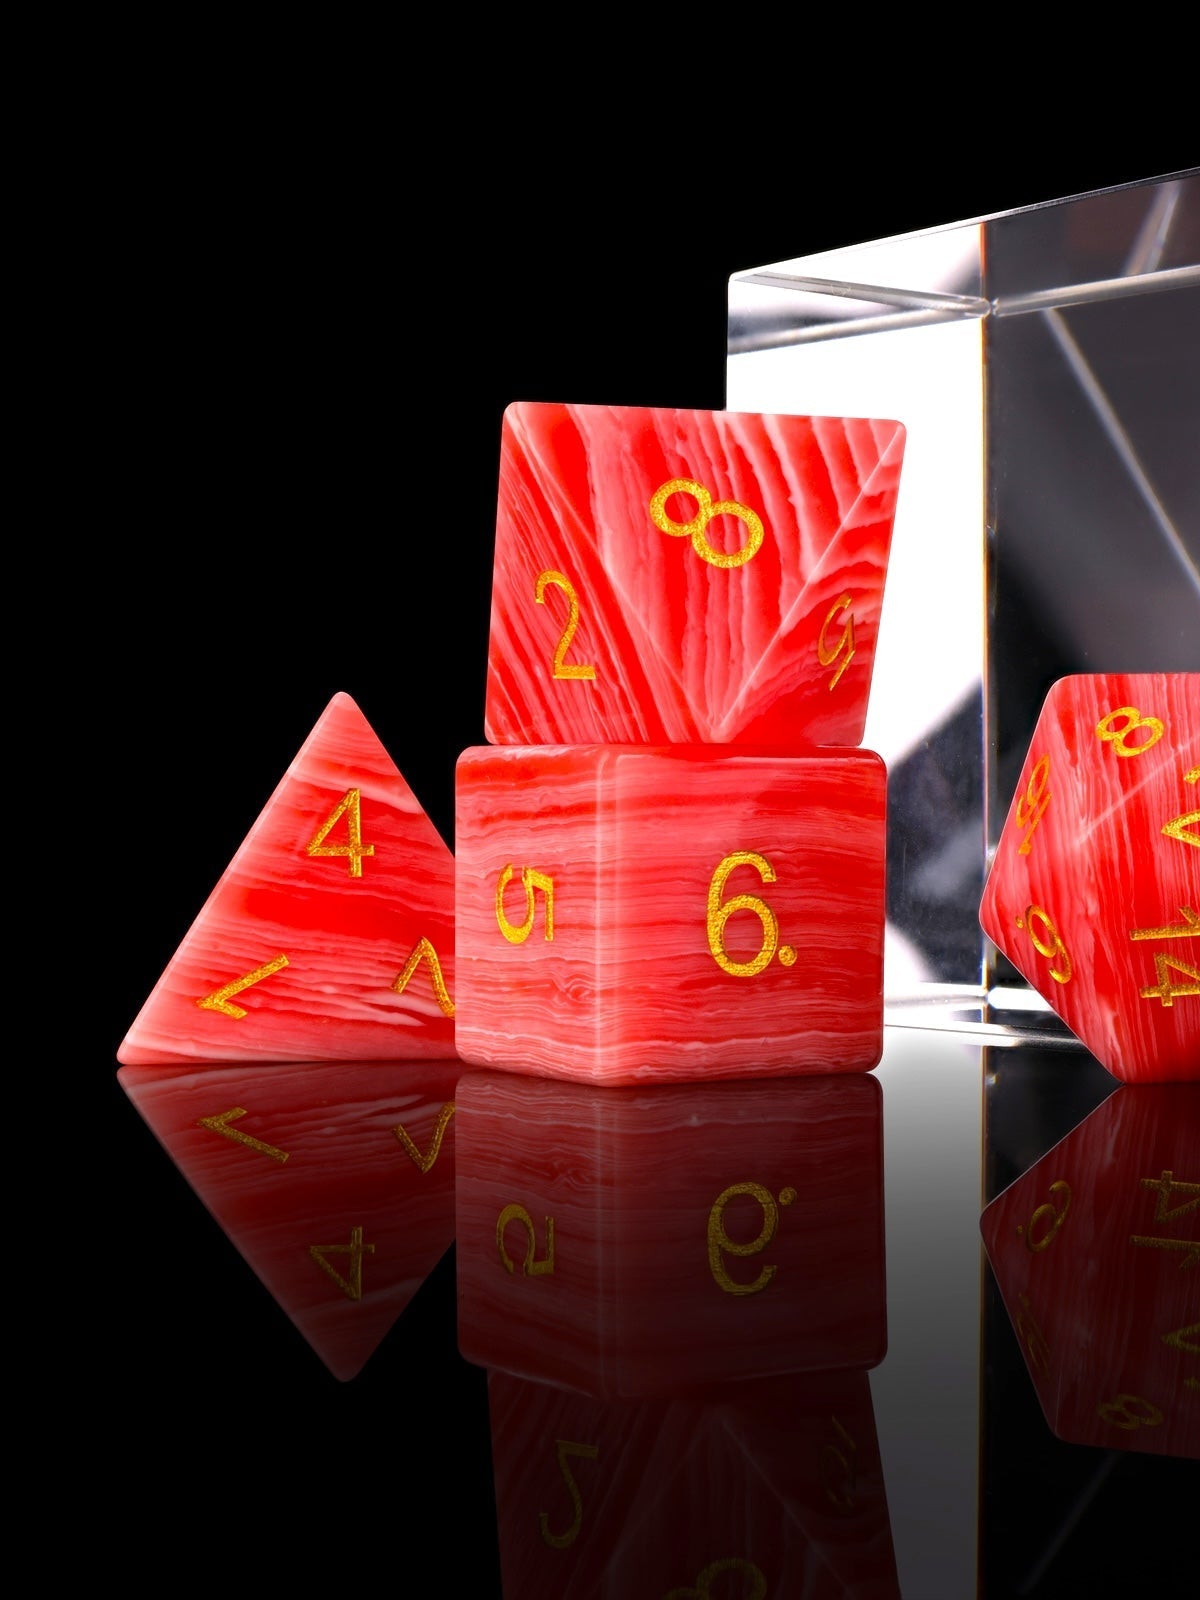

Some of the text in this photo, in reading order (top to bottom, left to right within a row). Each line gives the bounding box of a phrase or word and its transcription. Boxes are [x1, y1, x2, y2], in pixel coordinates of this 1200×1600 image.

[650, 478, 764, 568] 8
[535, 569, 596, 680] 2
[1095, 707, 1165, 757] 8
[308, 788, 374, 878] 4
[495, 864, 555, 945] 5
